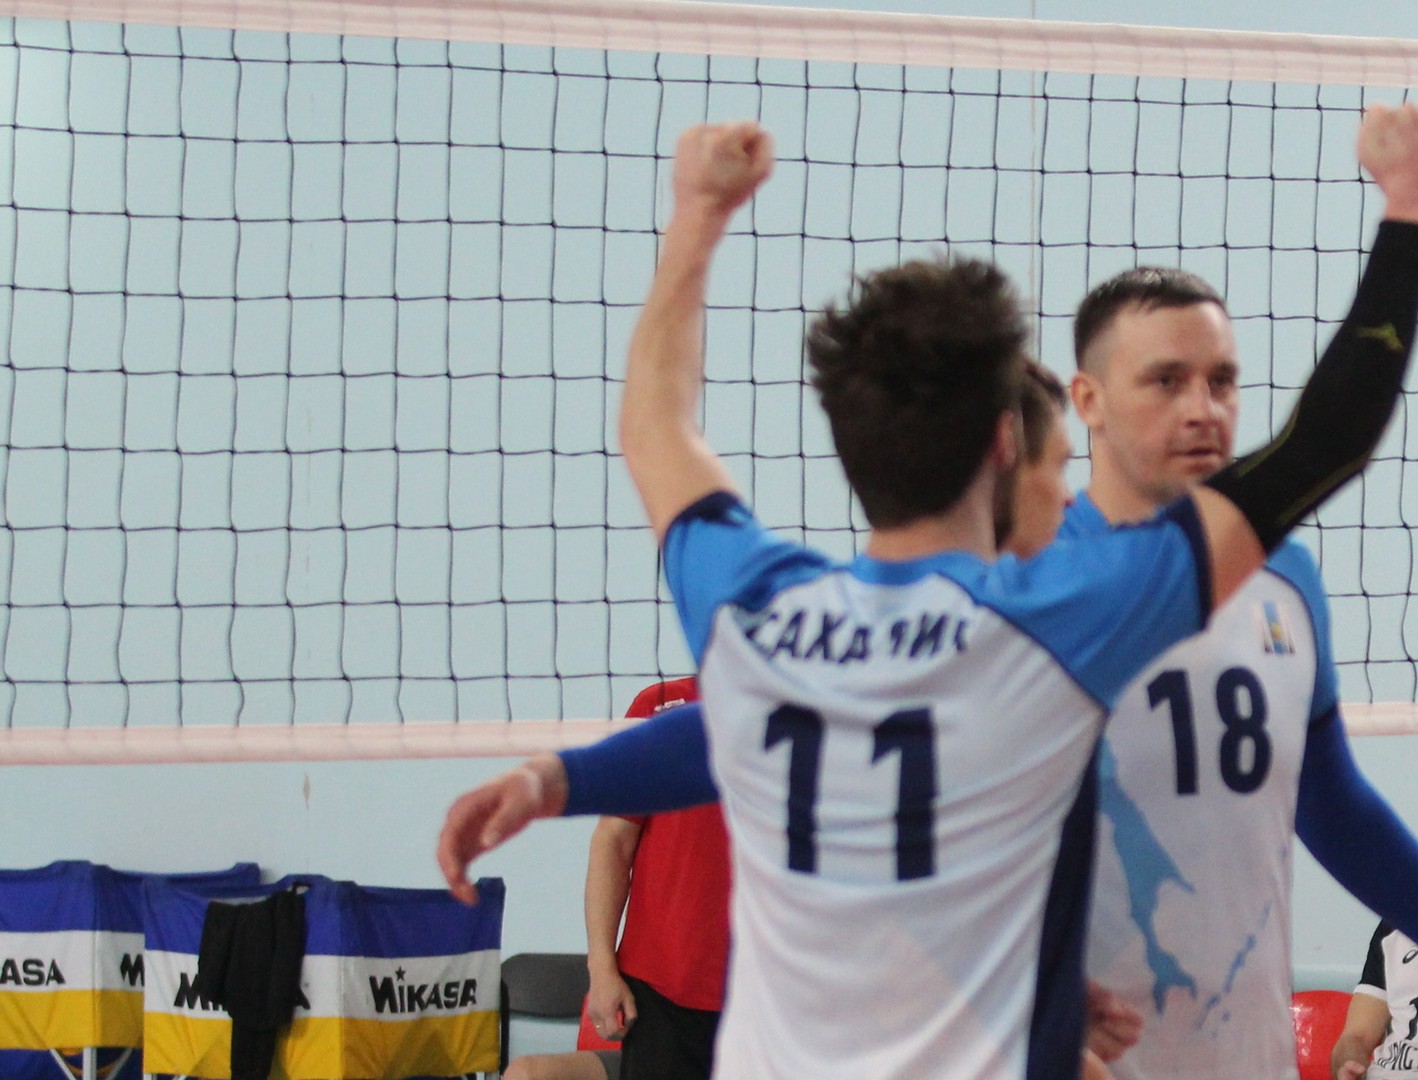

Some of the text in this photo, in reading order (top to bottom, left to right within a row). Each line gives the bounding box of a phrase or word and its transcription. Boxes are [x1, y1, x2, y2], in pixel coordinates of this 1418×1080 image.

[764, 704, 937, 881] 11
[1147, 667, 1271, 795] 18
[0, 958, 66, 985] ASA
